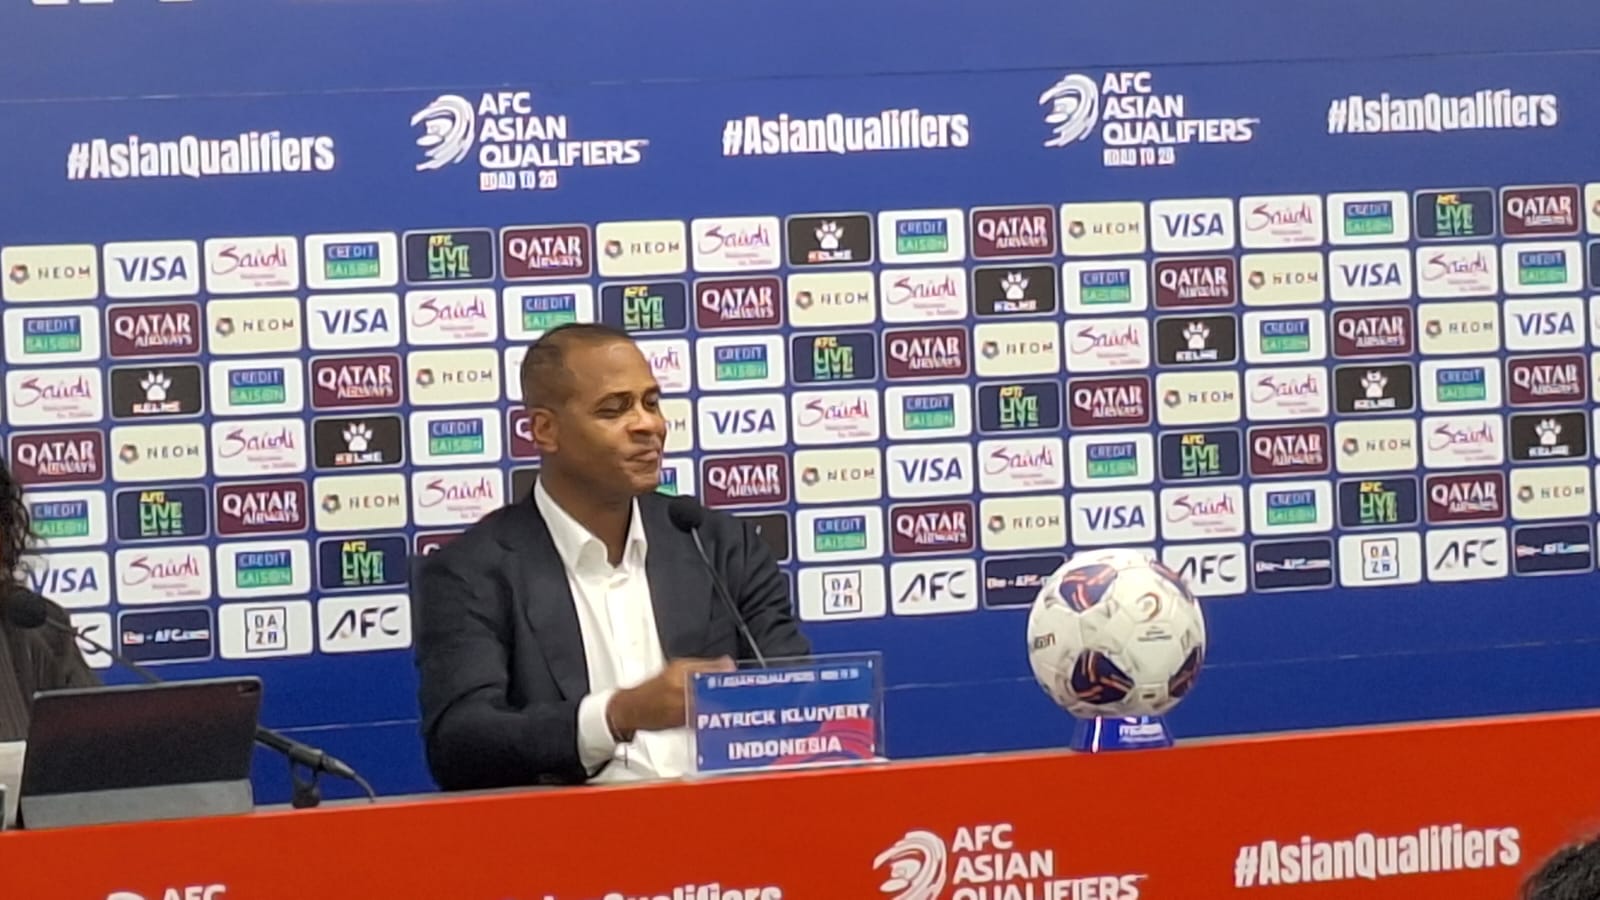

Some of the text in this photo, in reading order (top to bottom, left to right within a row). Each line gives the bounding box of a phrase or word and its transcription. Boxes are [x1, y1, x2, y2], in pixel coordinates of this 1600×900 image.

[1102, 72, 1152, 95] AFC
[478, 91, 531, 115] AFC
[1102, 94, 1184, 120] ASIAN
[1328, 89, 1557, 134] #AsianQualifiers
[479, 115, 567, 142] ASIAN
[723, 108, 970, 157] #AsianQualifiers
[1102, 118, 1256, 146] QUALIFIERS
[67, 131, 335, 179] #AsianQualifiers
[479, 139, 645, 169] QUALIFIERS
[1508, 196, 1572, 218] QATAR
[978, 217, 1047, 240] QATAR
[1160, 213, 1225, 238] VISA
[508, 236, 581, 260] QATAR
[114, 256, 188, 282] VISA
[1160, 267, 1228, 290] QATAR
[1338, 263, 1402, 288] VISA
[702, 287, 773, 311] QATAR
[115, 313, 191, 338] QATAR
[317, 308, 389, 334] VISA
[1339, 316, 1405, 339] QATAR
[1513, 311, 1575, 336] VISA
[890, 337, 960, 361] QATAR
[317, 365, 392, 389] QATAR
[1075, 386, 1143, 410] QATAR
[707, 409, 776, 435] VISA
[18, 440, 95, 466] QATAR
[147, 445, 199, 458] NEOM
[708, 464, 779, 489] QATAR
[896, 458, 963, 484] VISA
[223, 491, 298, 516] QATAR
[349, 495, 400, 508] NEOM
[1431, 481, 1497, 505] QATAR
[897, 512, 966, 537] QATAR
[1080, 505, 1146, 531] VISA
[1433, 538, 1498, 569] AFC
[28, 567, 98, 593] VISA
[898, 571, 968, 604] AFC
[326, 606, 400, 640] AFC
[698, 703, 870, 730] PATRICK KLUIVERT
[952, 824, 1013, 853] AFC
[953, 850, 1054, 885] ASIAN
[1235, 824, 1520, 888] #AsianQualifiers
